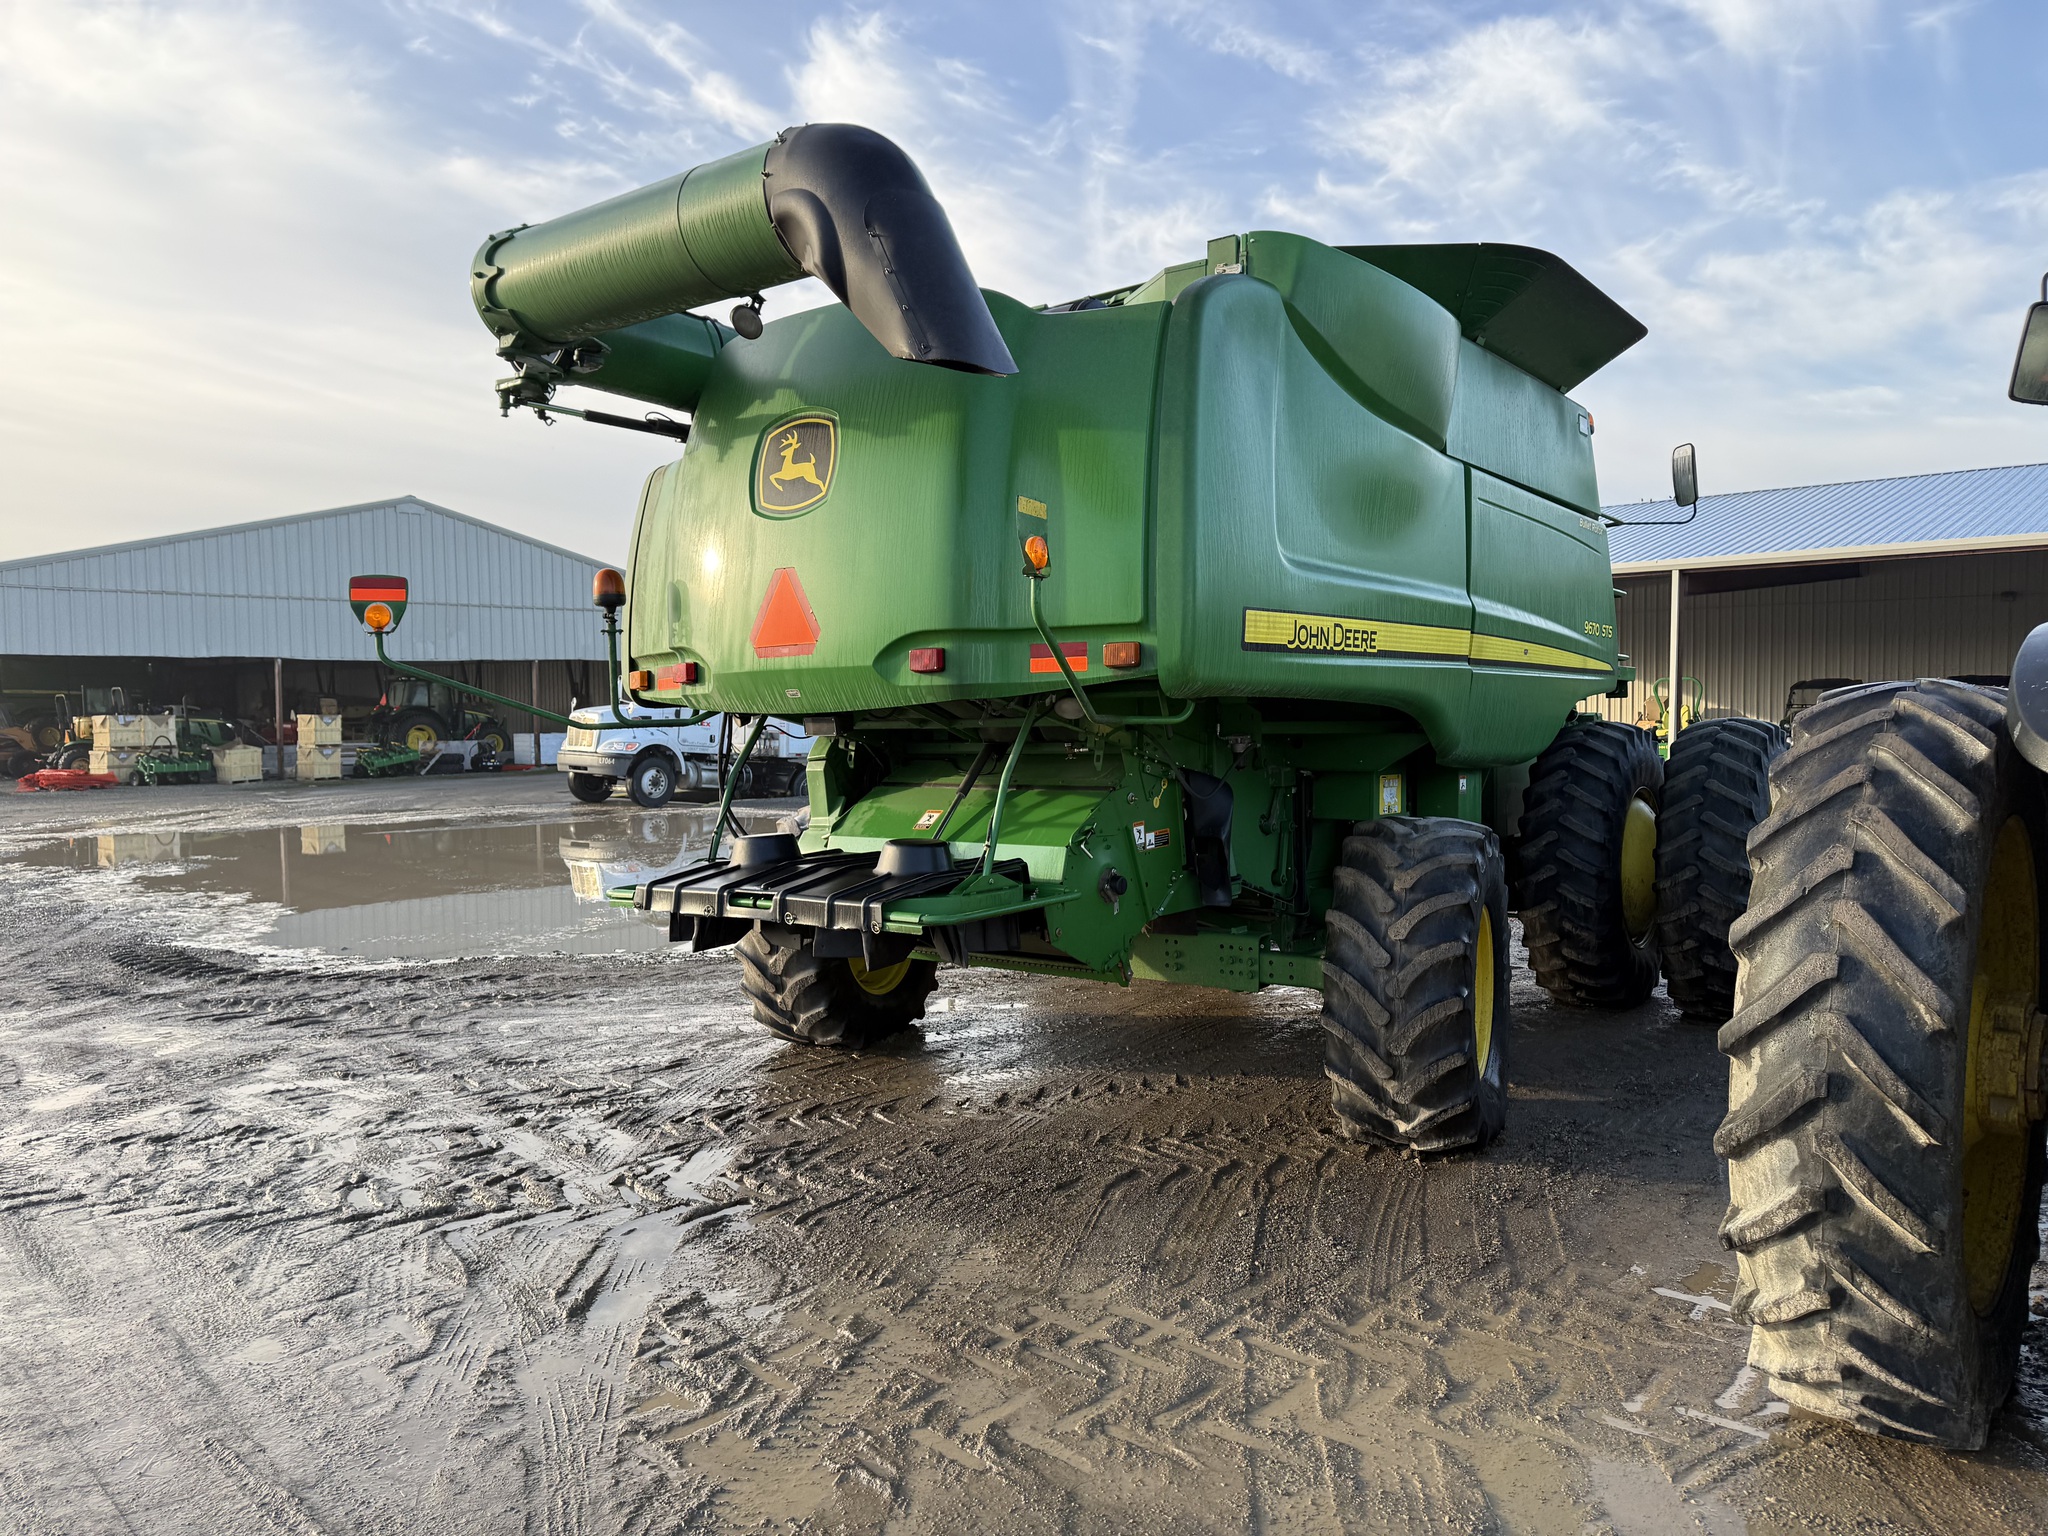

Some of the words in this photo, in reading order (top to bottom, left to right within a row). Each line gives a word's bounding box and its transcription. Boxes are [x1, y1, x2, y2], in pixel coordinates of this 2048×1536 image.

[1287, 619, 1330, 648] JOHN
[1333, 622, 1378, 651] DEERE
[1584, 620, 1600, 636] 9670
[1601, 624, 1613, 638] STS
